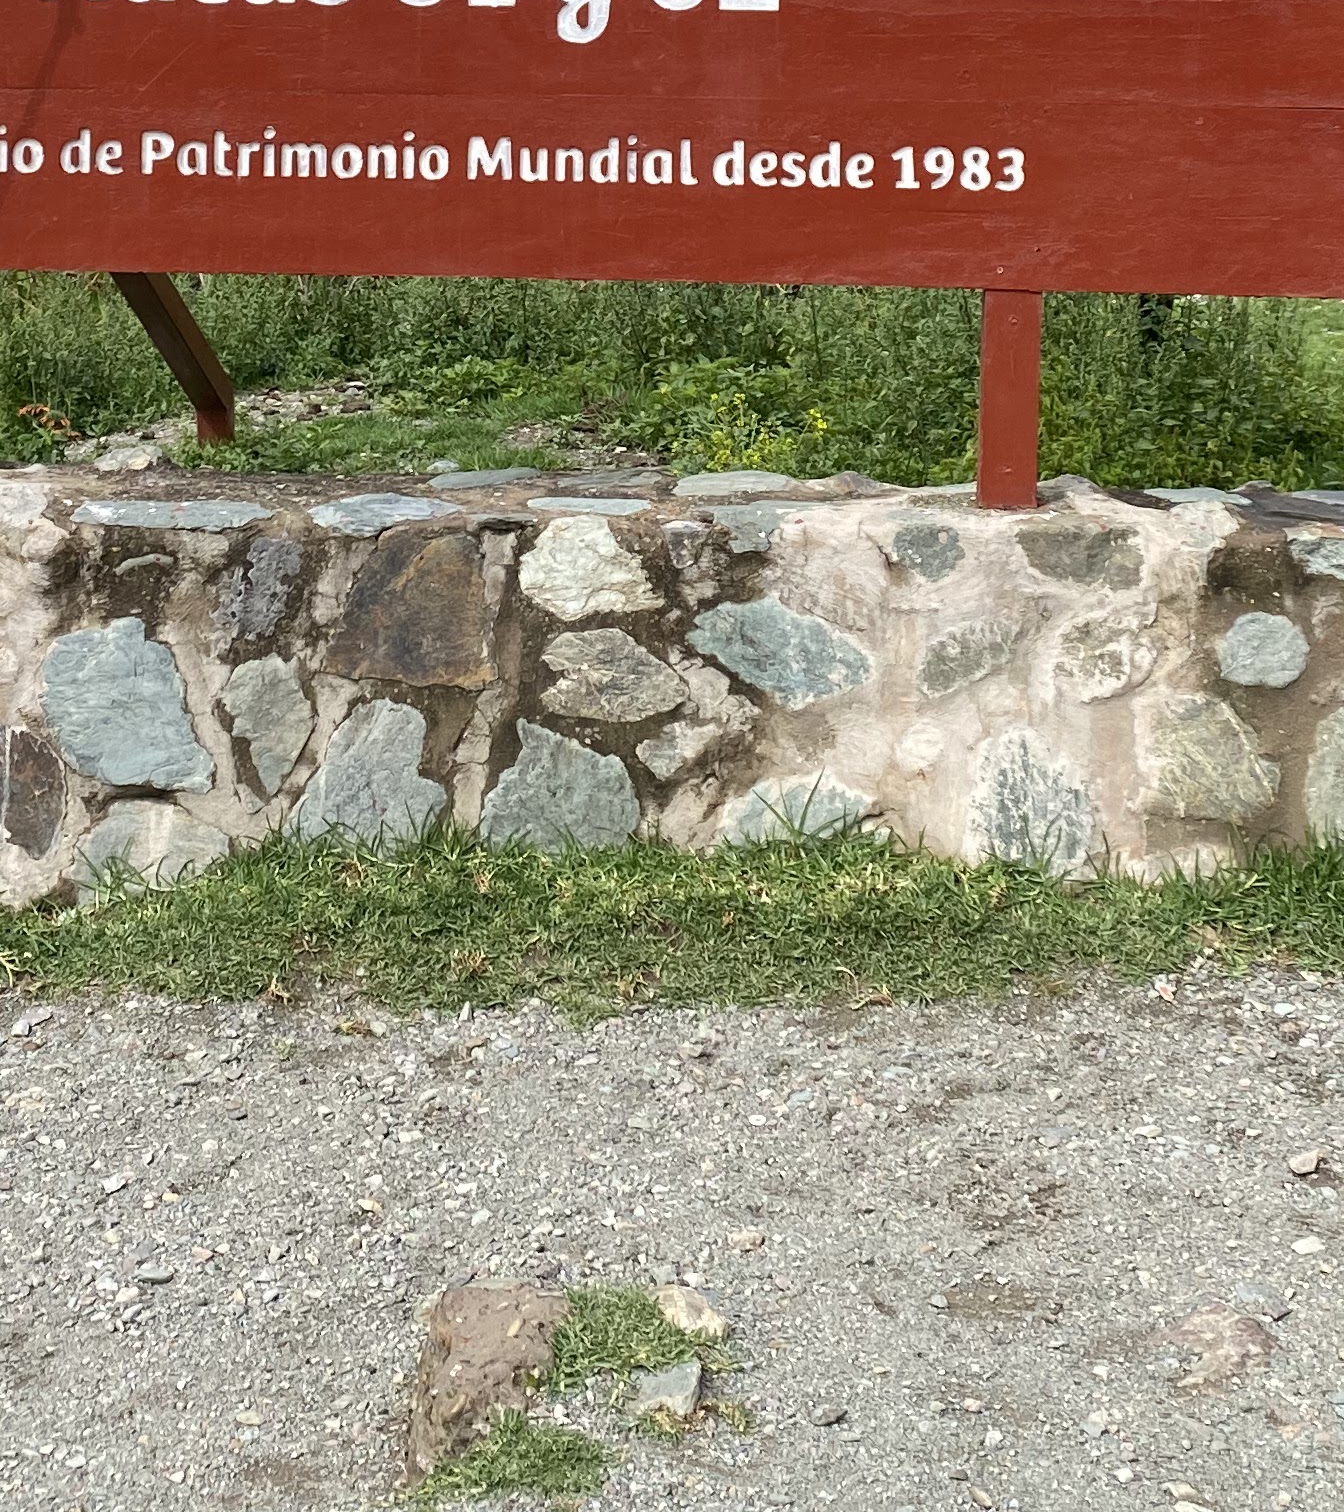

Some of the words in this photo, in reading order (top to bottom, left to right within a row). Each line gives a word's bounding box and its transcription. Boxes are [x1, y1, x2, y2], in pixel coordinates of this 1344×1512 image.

[60, 128, 124, 175] de
[141, 126, 449, 181] Patrimonio
[467, 133, 699, 186] Mundial
[712, 140, 875, 189] desde
[891, 146, 1025, 192] 1983
